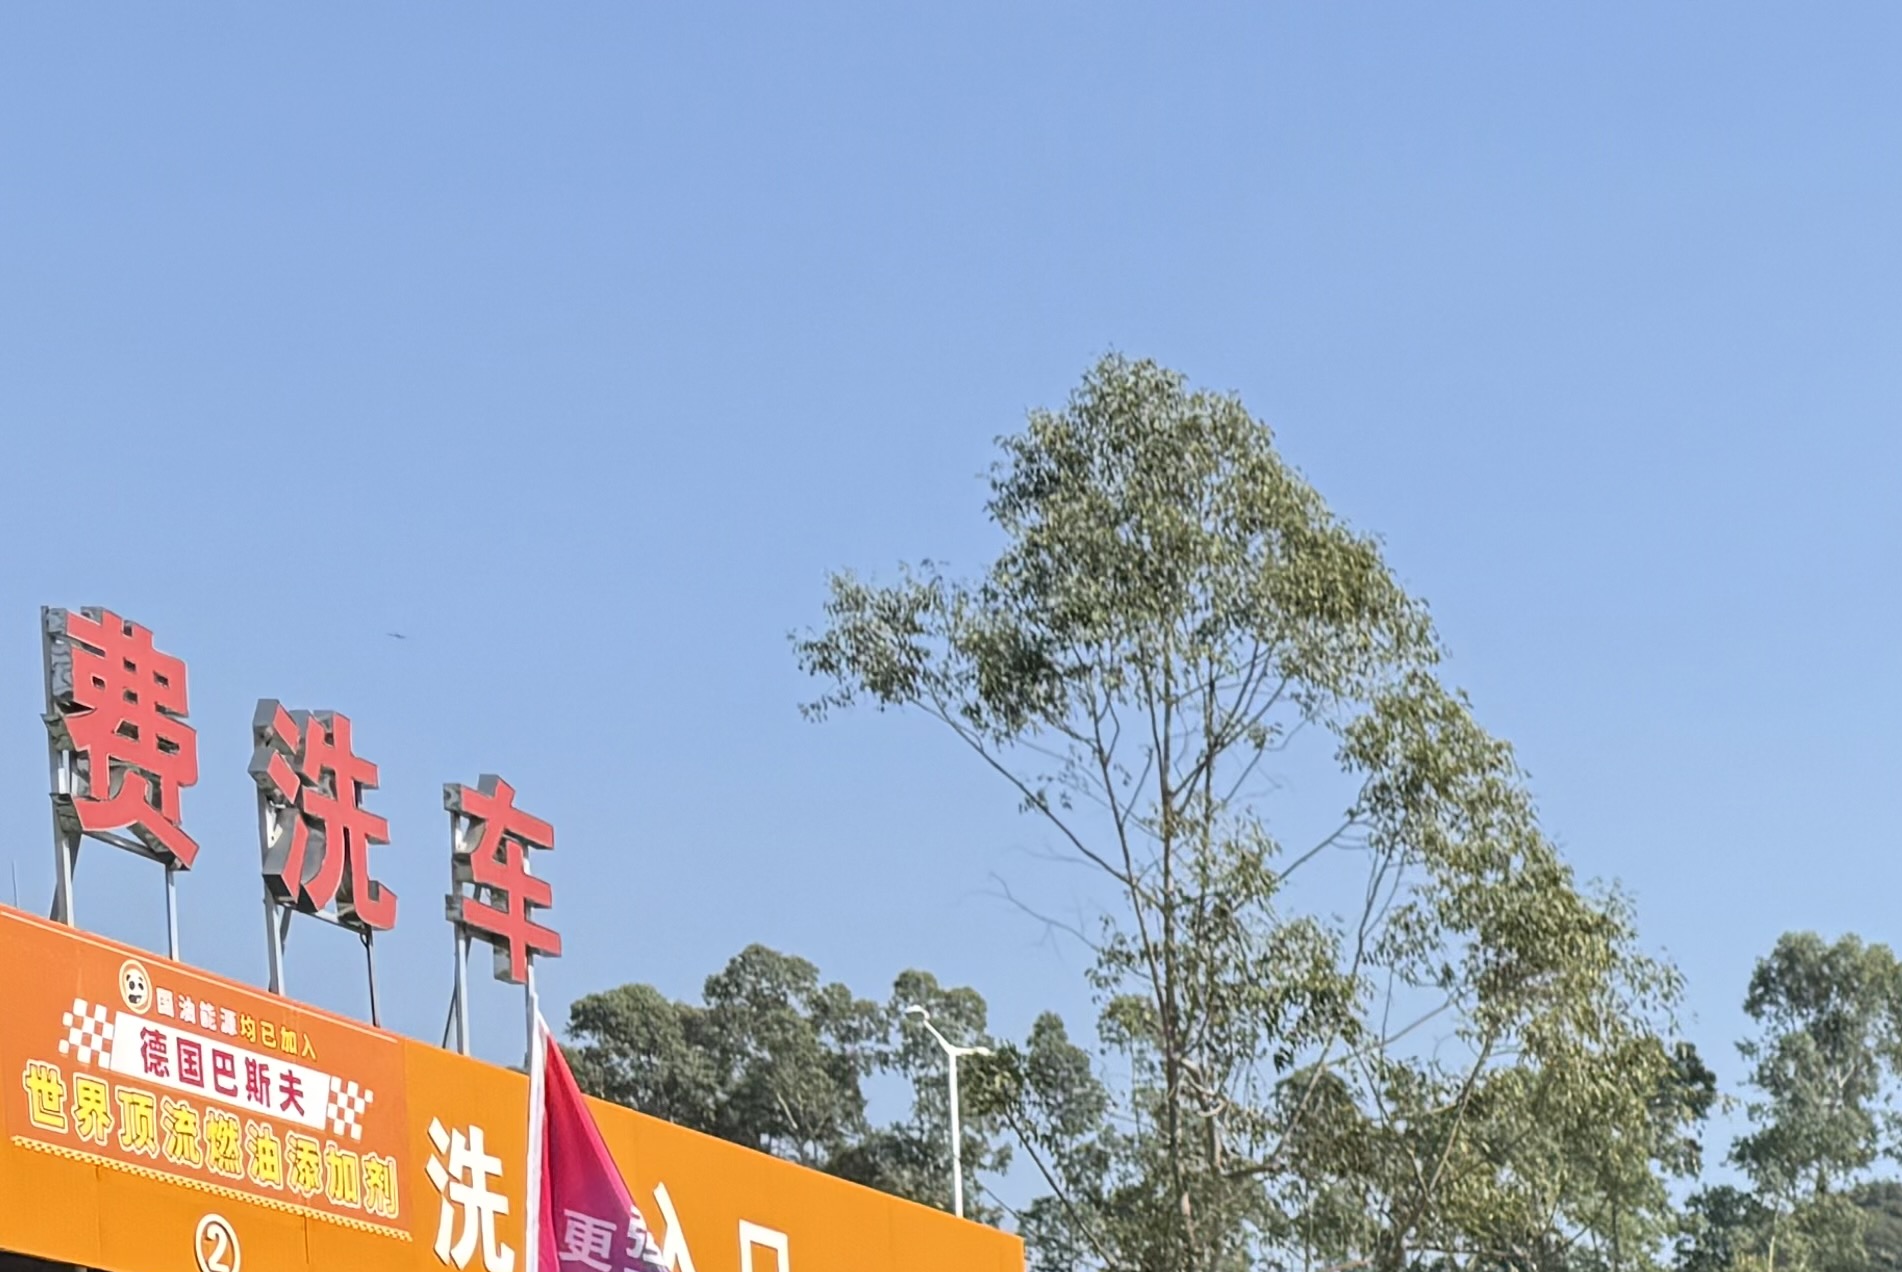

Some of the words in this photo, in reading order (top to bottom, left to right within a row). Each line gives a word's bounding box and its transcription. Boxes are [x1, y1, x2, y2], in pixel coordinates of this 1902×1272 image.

[45, 606, 562, 984] 费洗车
[140, 1027, 305, 1117] 德国巴斯夫
[155, 987, 317, 1061] 国油能源均已加入
[23, 1058, 400, 1220] 世界顶流燃油添加剂
